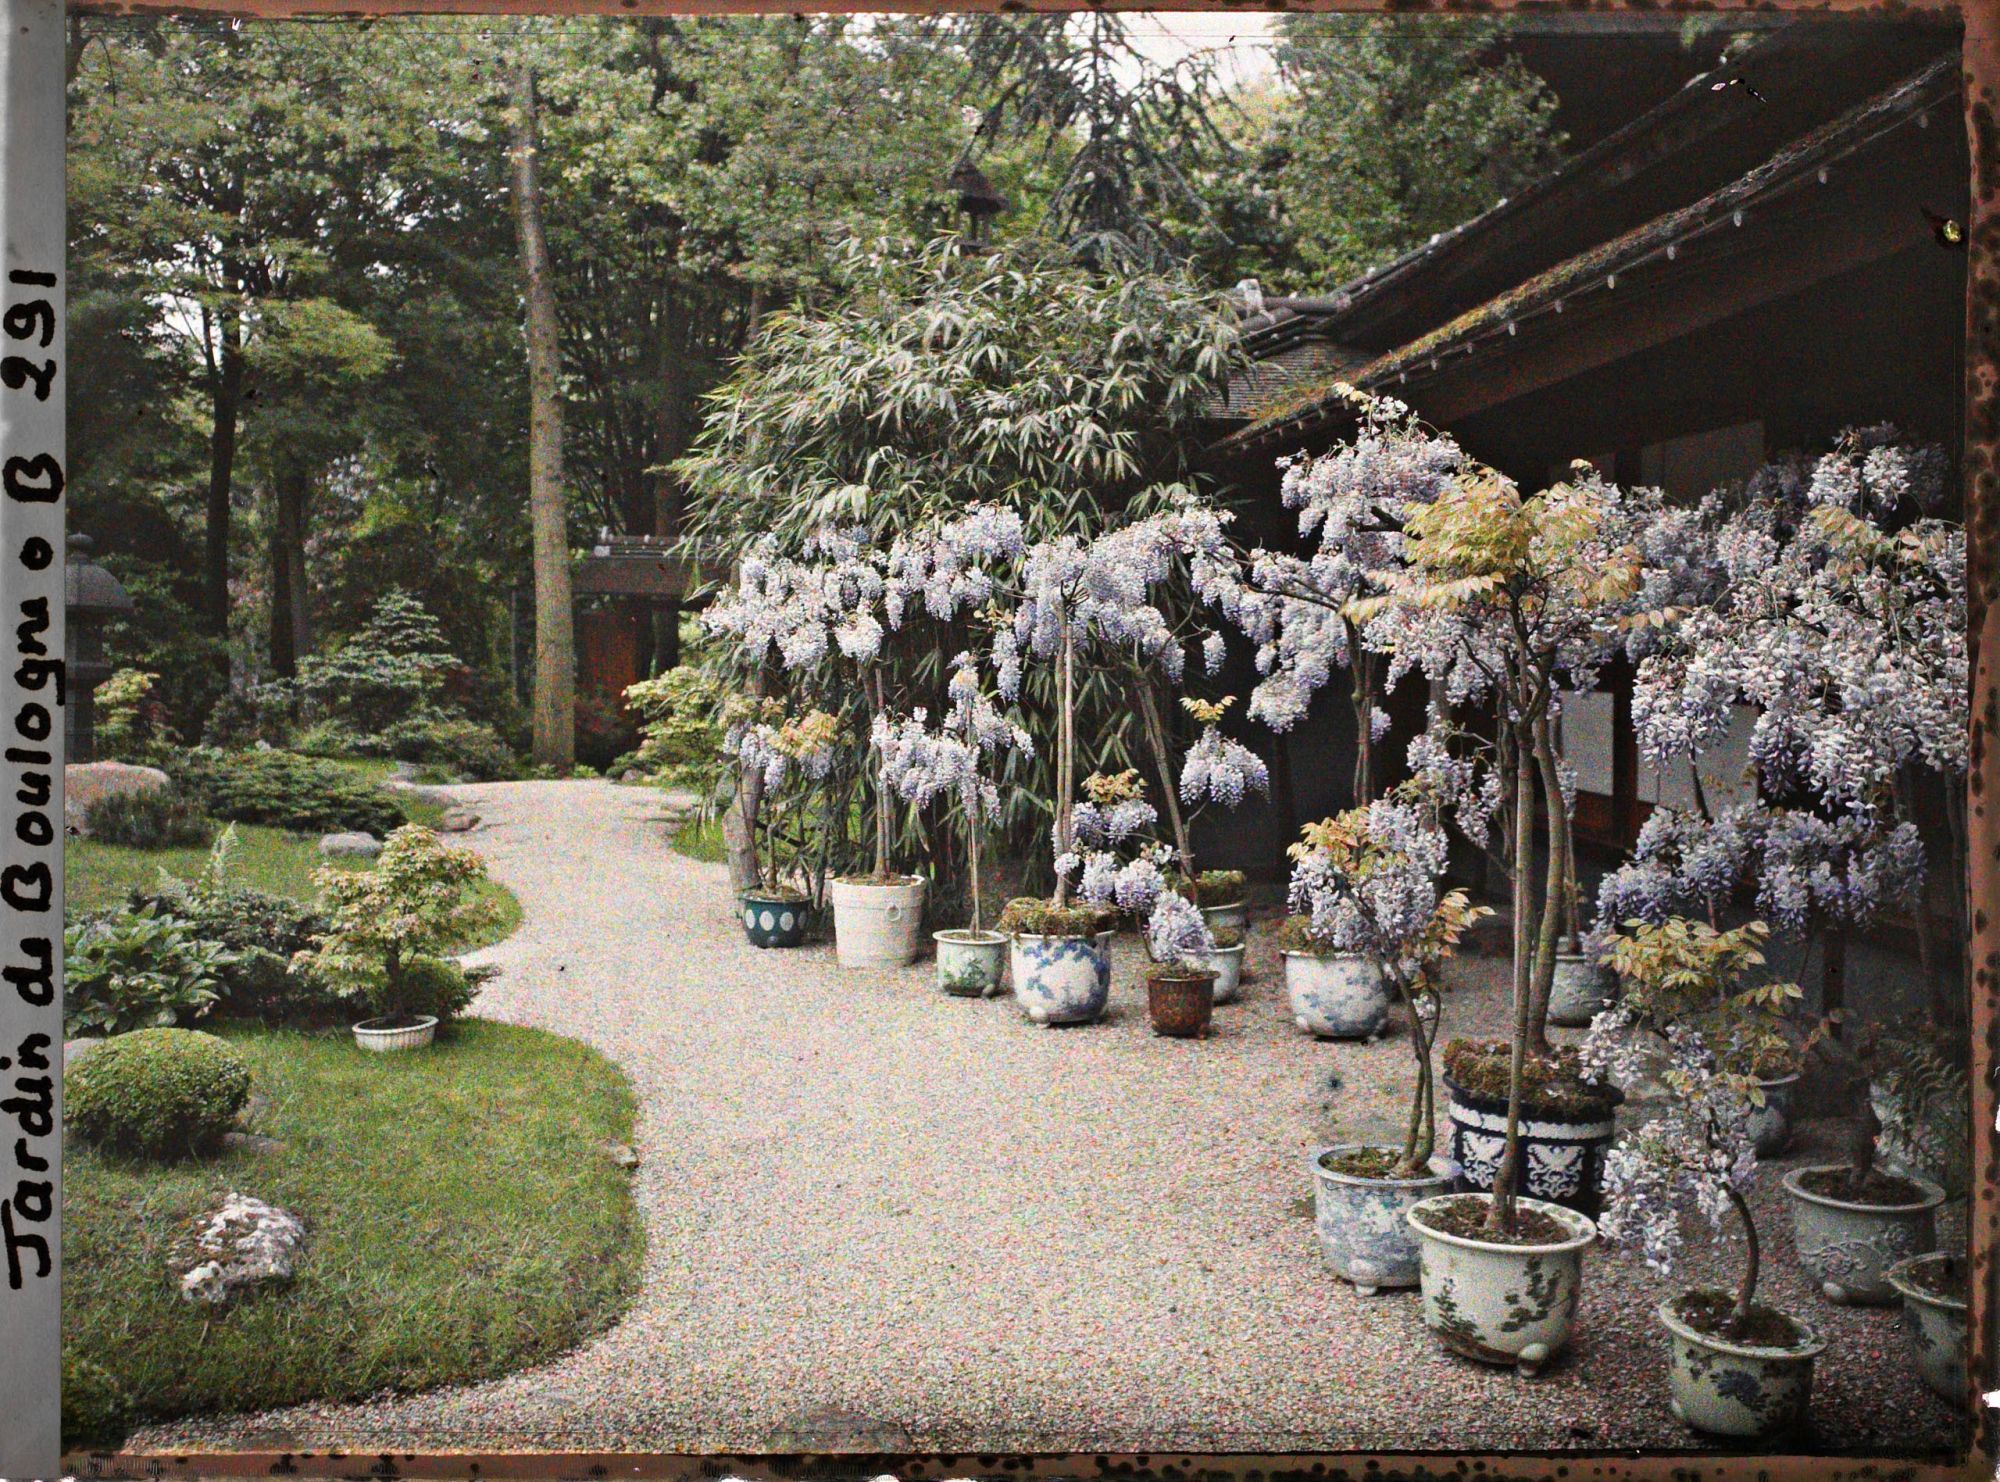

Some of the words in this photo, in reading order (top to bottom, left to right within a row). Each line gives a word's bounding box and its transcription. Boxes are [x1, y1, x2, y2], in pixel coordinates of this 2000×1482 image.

[0, 268, 58, 403] 291
[2, 452, 65, 504] B
[0, 595, 65, 914] Boulogne
[1, 936, 55, 1008] de
[1, 1033, 55, 1290] Jardin
